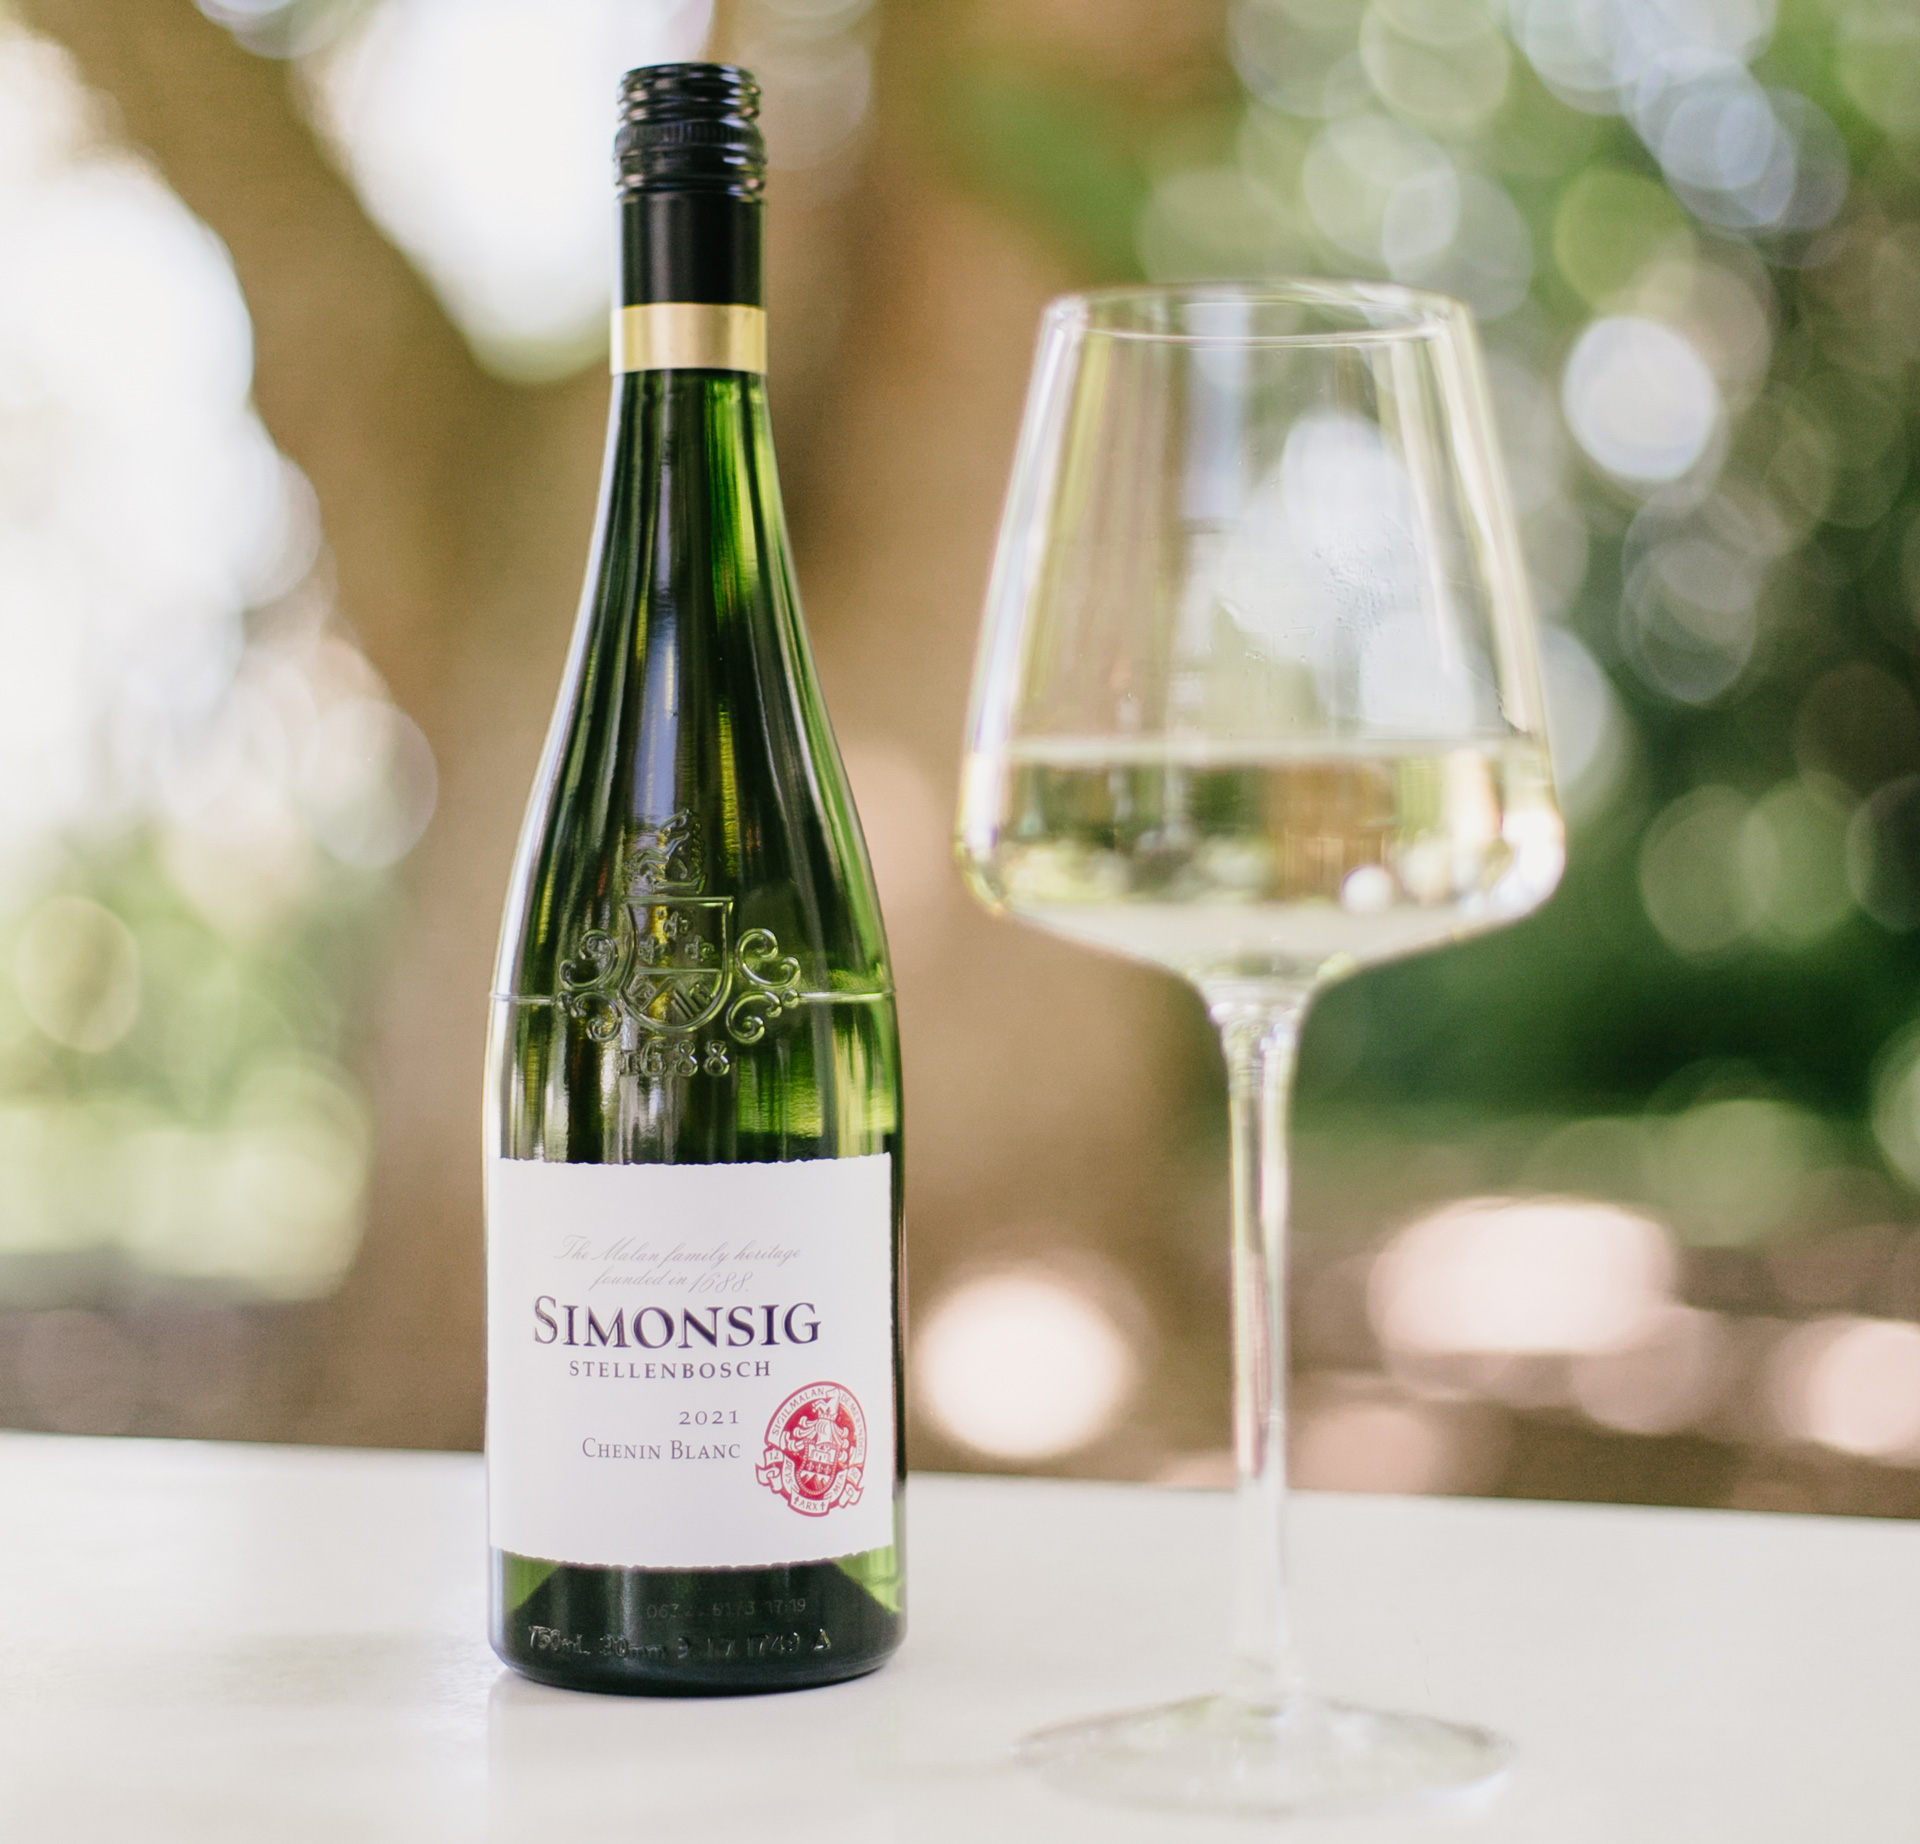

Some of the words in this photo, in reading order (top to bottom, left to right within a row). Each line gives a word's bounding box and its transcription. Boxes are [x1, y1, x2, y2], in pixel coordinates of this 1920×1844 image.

[553, 1234, 592, 1261] The
[591, 1236, 659, 1262] Malan
[657, 1241, 729, 1269] family
[733, 1240, 802, 1267] heritage
[588, 1265, 671, 1292] founded
[668, 1272, 689, 1286] in
[533, 1295, 822, 1349] SIMONSIG
[569, 1360, 772, 1379] STELLENBOSCH
[678, 1409, 740, 1425] 2021
[582, 1437, 662, 1459] CHENIN
[670, 1439, 741, 1460] BLANC
